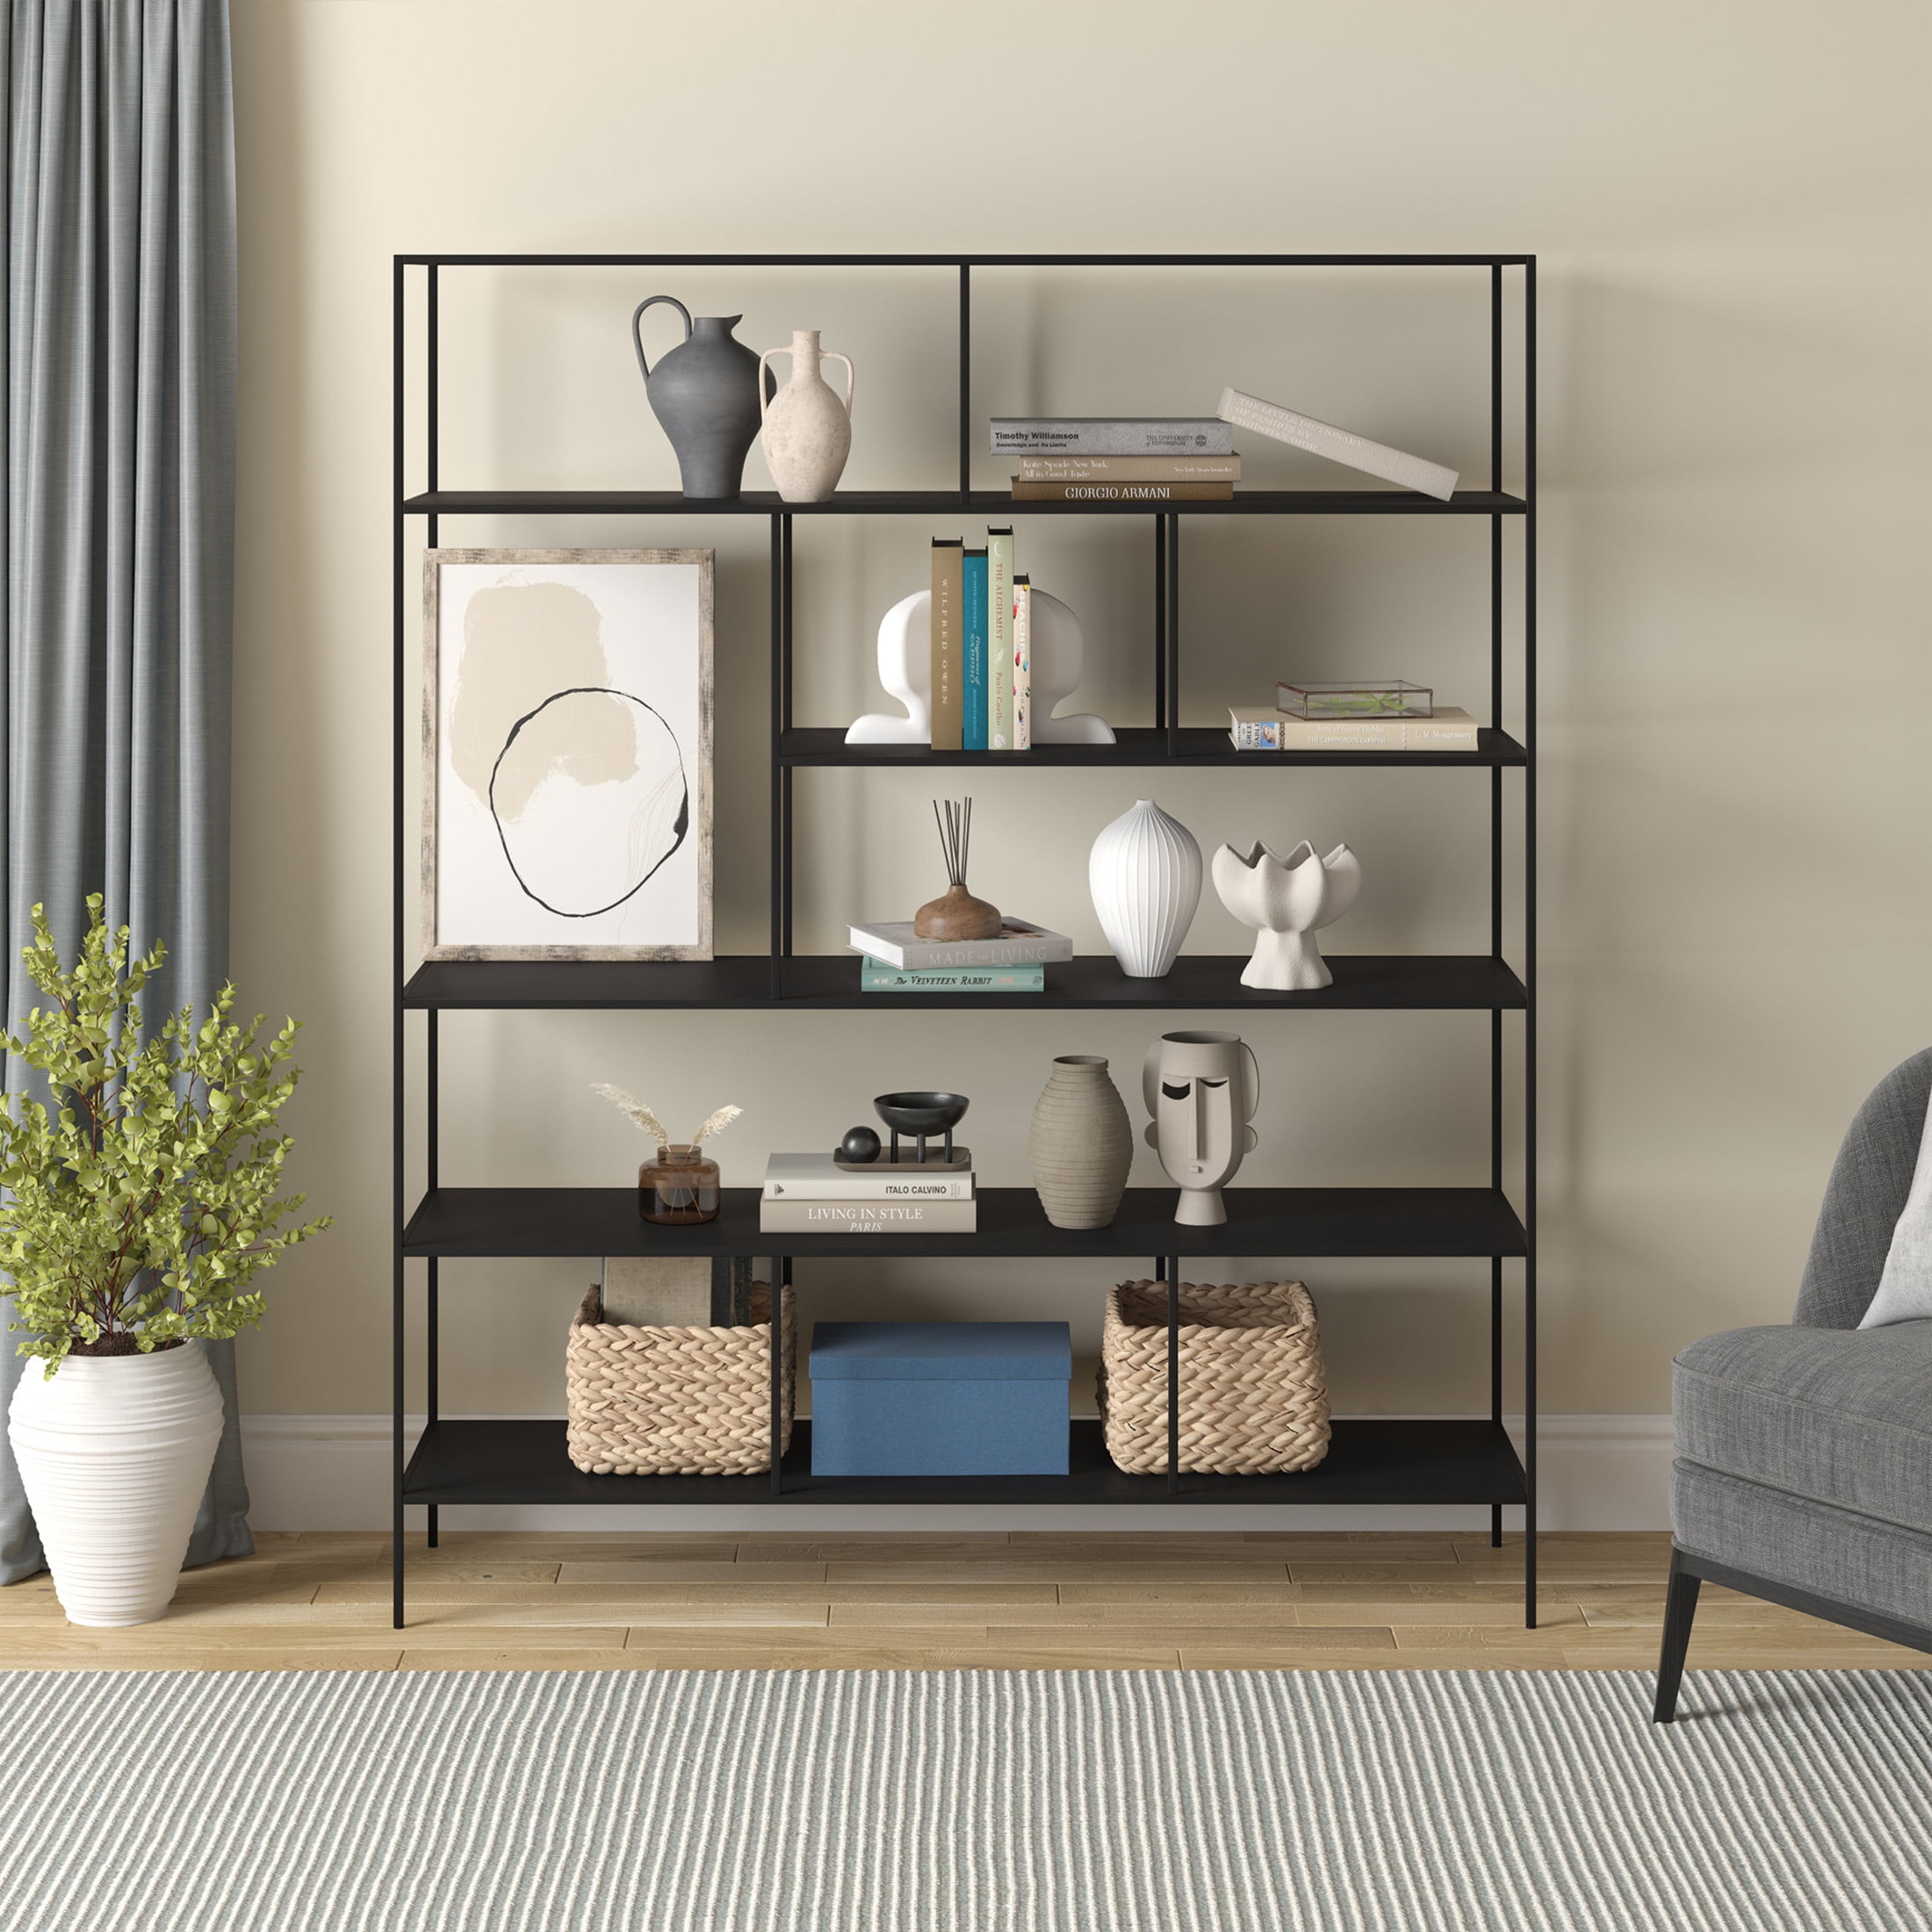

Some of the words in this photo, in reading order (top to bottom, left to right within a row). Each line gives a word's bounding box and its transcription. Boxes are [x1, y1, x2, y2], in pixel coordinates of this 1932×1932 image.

[995, 432, 1029, 441] Timothy
[1023, 459, 1042, 468] Kate
[1044, 459, 1071, 472] Spade
[1073, 459, 1088, 468] New
[1065, 487, 1118, 500] GIORGIO
[1121, 487, 1171, 500] ARMANI
[1433, 731, 1473, 739] Montgomery
[928, 950, 976, 966] MADE
[991, 947, 1048, 963] LIVING
[894, 977, 907, 985] The
[911, 976, 957, 985] VELVETEEN
[961, 976, 992, 985] RABBIT
[885, 1186, 909, 1194] ITALO
[911, 1186, 947, 1194] CALVINO
[808, 1208, 856, 1220] LIVING
[861, 1208, 875, 1220] IN
[880, 1208, 923, 1220] STYLE
[849, 1222, 883, 1232] PARIS
